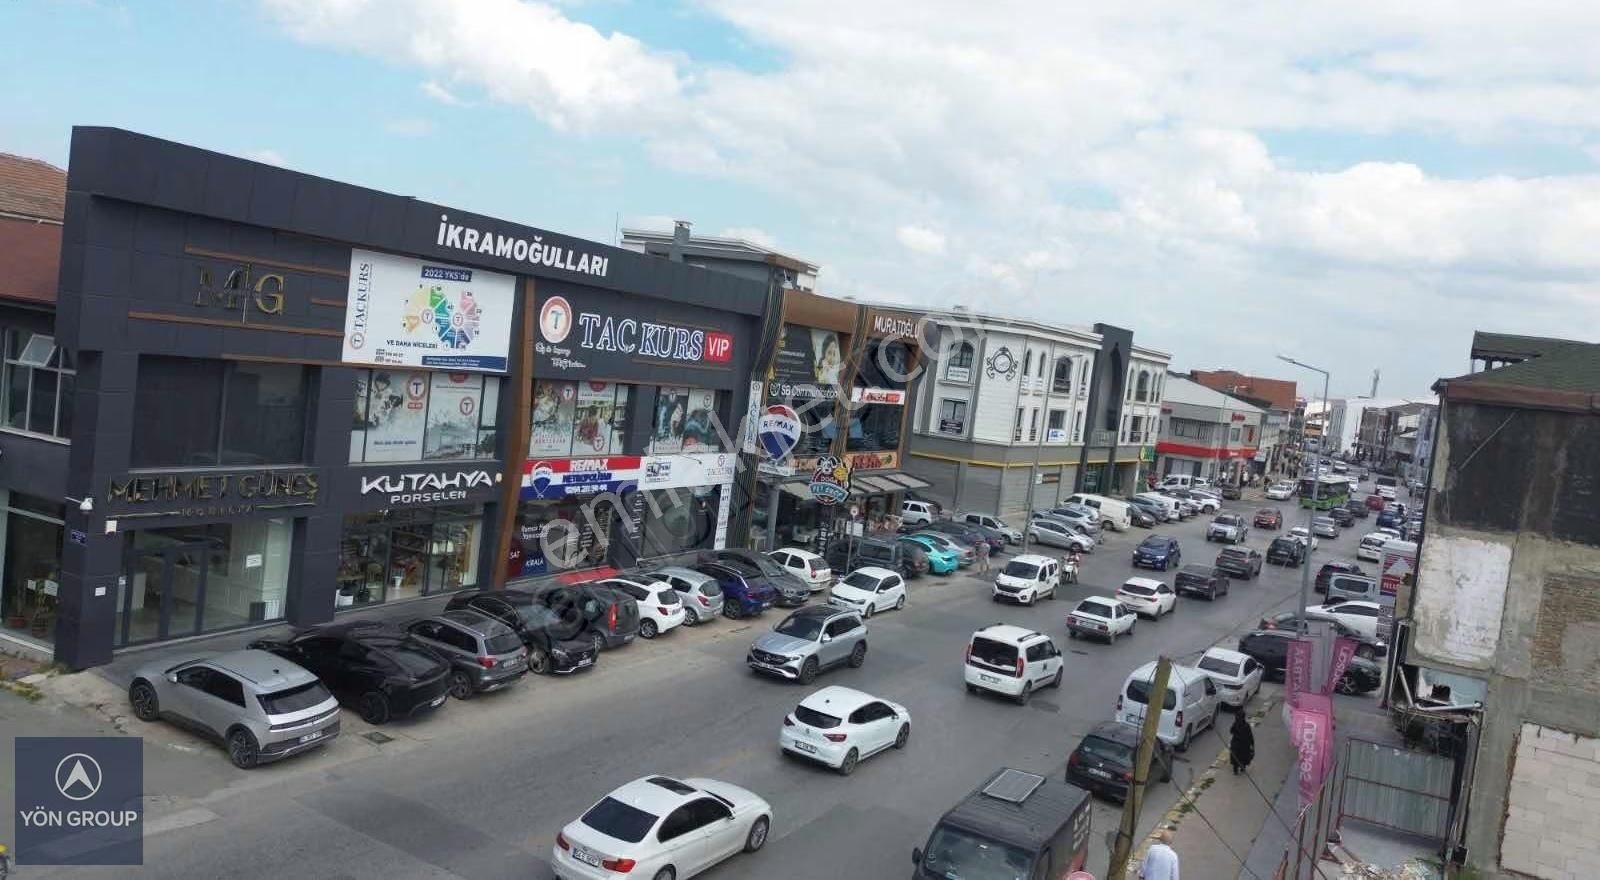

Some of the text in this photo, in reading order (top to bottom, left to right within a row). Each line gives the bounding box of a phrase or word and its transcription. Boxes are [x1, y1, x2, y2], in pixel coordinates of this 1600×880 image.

[436, 214, 609, 277] İKRAMOĞULLARI
[425, 268, 444, 278] 2022
[638, 322, 704, 361] KURS
[708, 336, 730, 357] VIP
[763, 419, 795, 433] RE/MAX
[390, 490, 467, 505] PORSELEN
